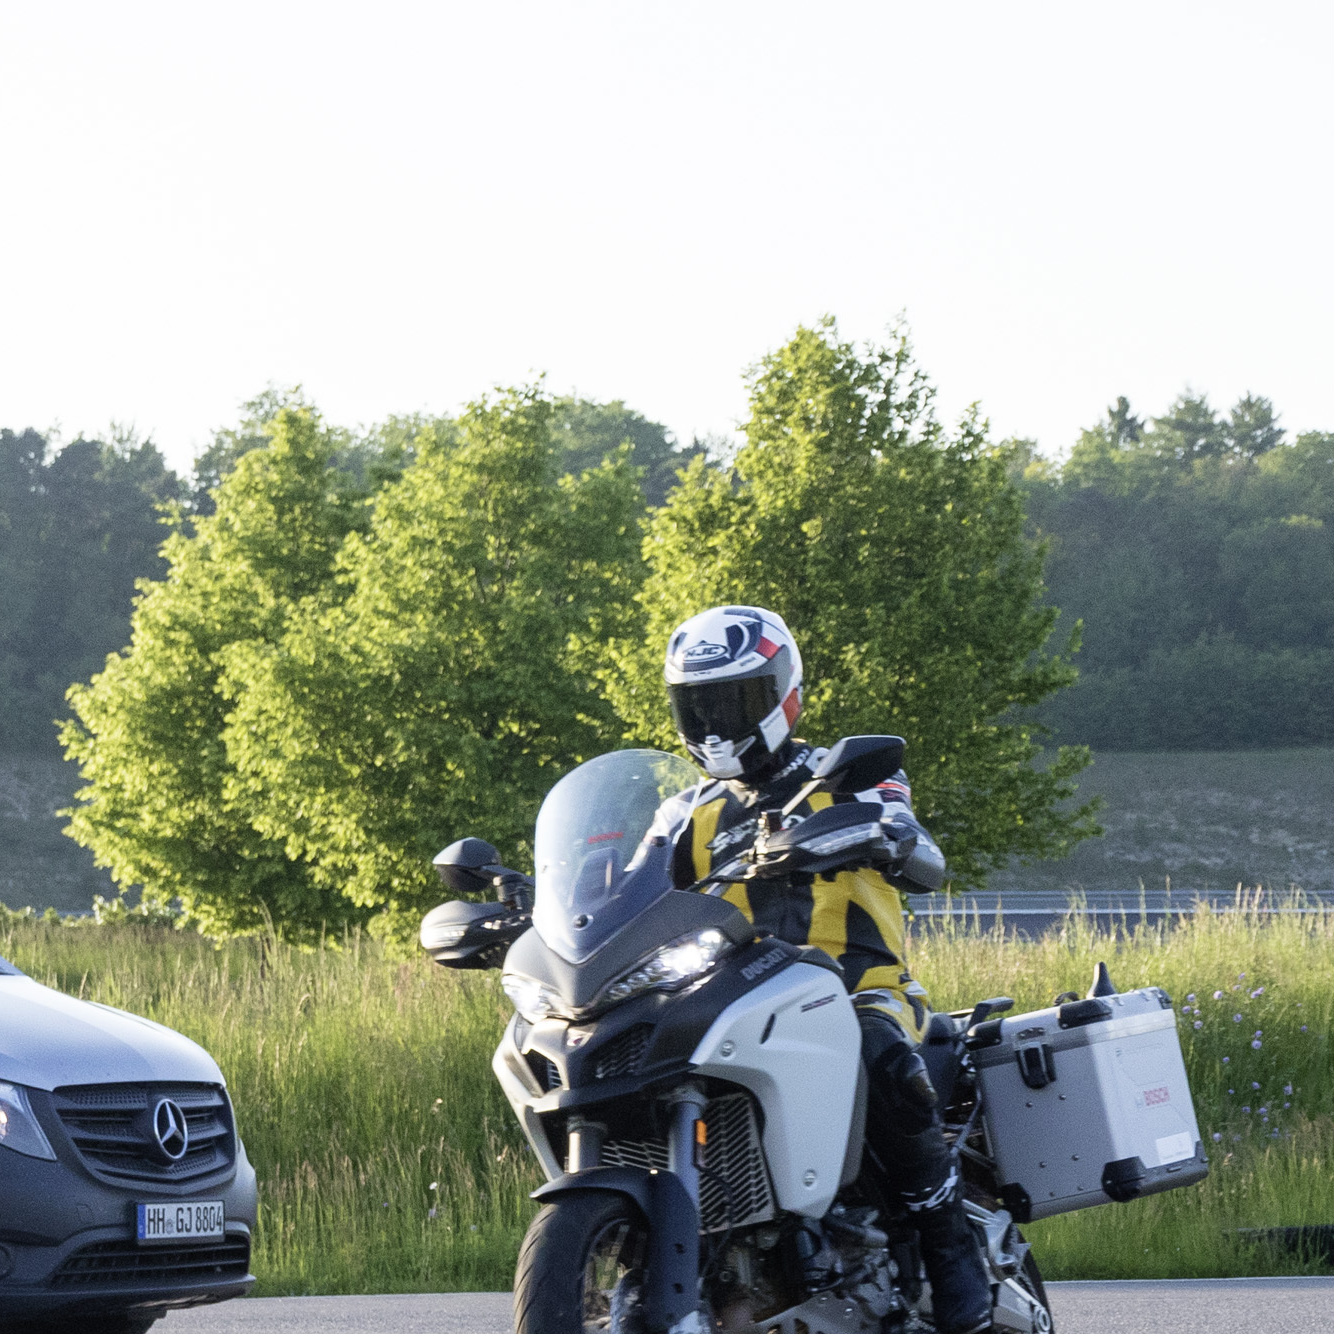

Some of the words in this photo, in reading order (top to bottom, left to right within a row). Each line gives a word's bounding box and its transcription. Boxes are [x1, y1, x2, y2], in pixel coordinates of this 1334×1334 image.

[740, 947, 788, 981] DUCATI
[147, 1208, 166, 1234] HH
[176, 1207, 192, 1232] GJ
[195, 1206, 223, 1232] 8804
